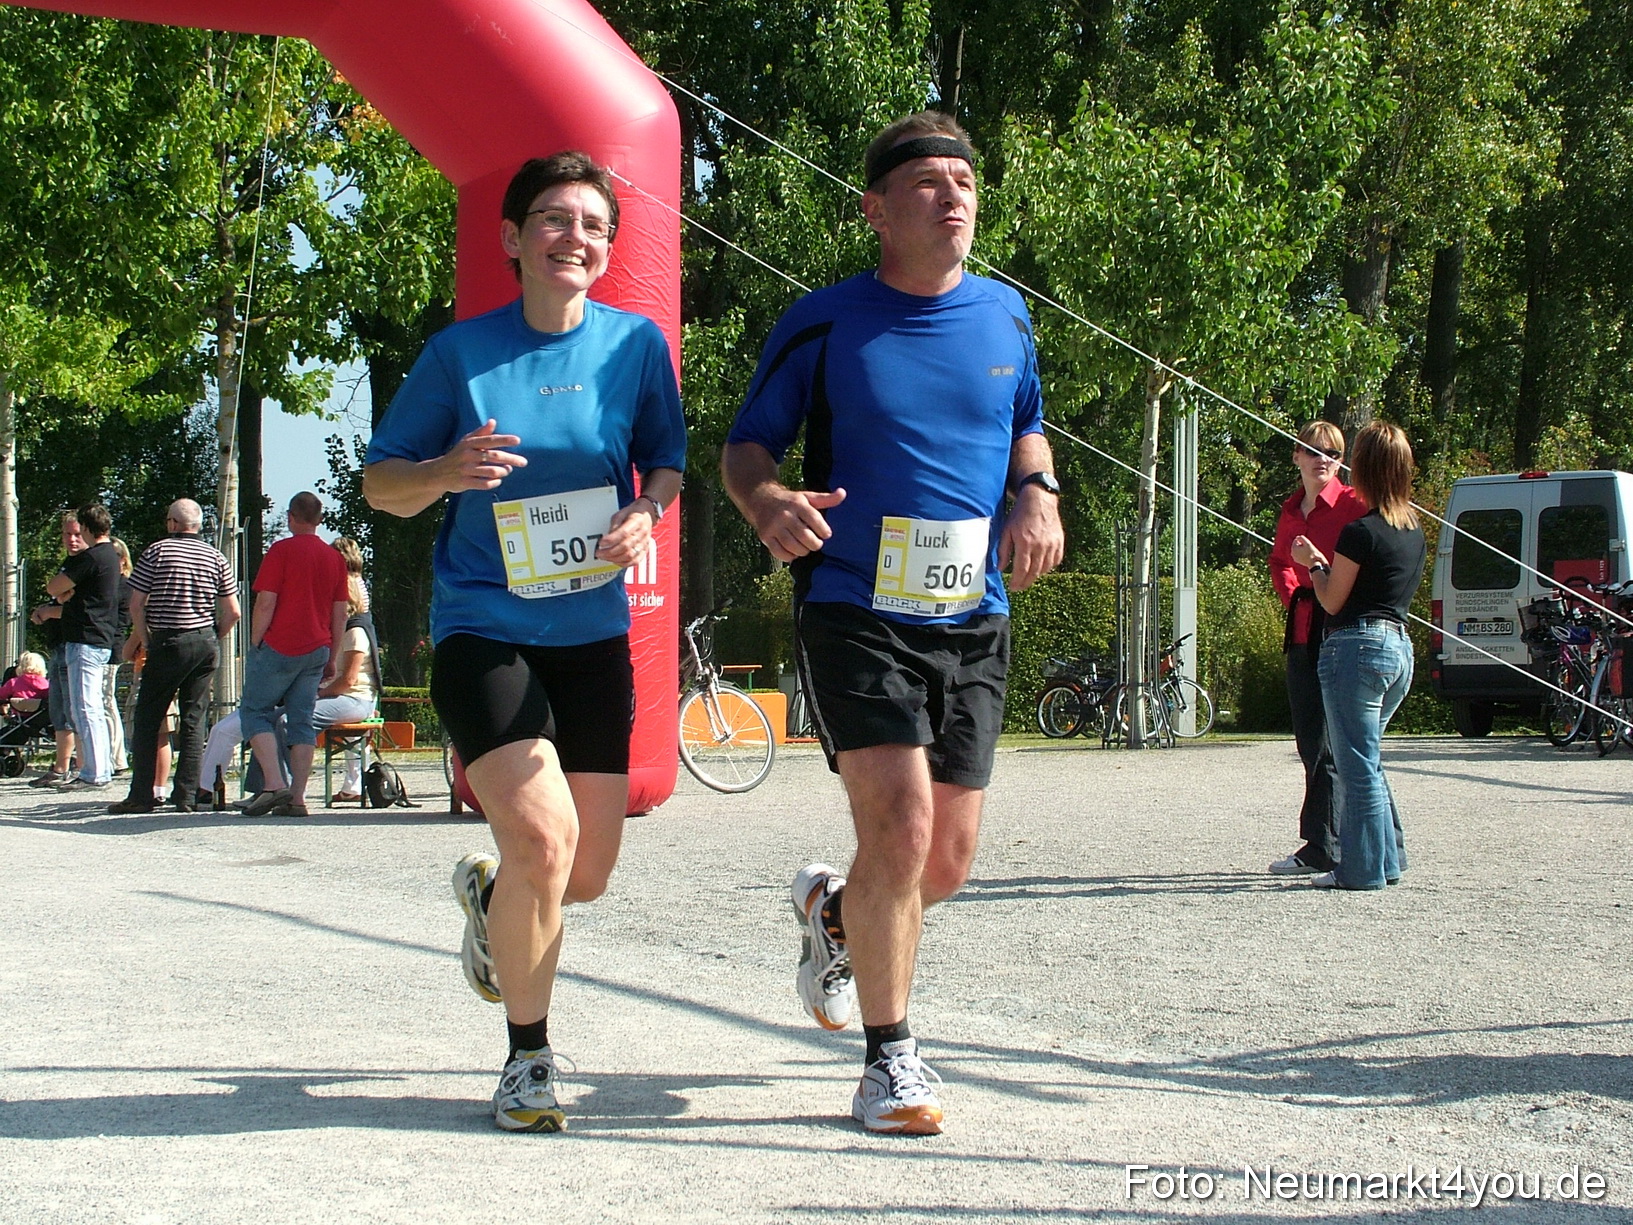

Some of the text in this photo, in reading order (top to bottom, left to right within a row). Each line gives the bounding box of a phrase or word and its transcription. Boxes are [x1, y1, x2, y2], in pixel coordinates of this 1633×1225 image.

[529, 503, 569, 526] Heidi
[507, 540, 516, 554] D
[914, 529, 950, 549] Luck
[551, 533, 603, 566] 507
[884, 554, 892, 569] D
[582, 571, 616, 584] PFLEIDER
[923, 563, 973, 590] 506
[640, 590, 665, 607] sicher
[1481, 624, 1493, 632] BS
[1494, 623, 1512, 632] 280
